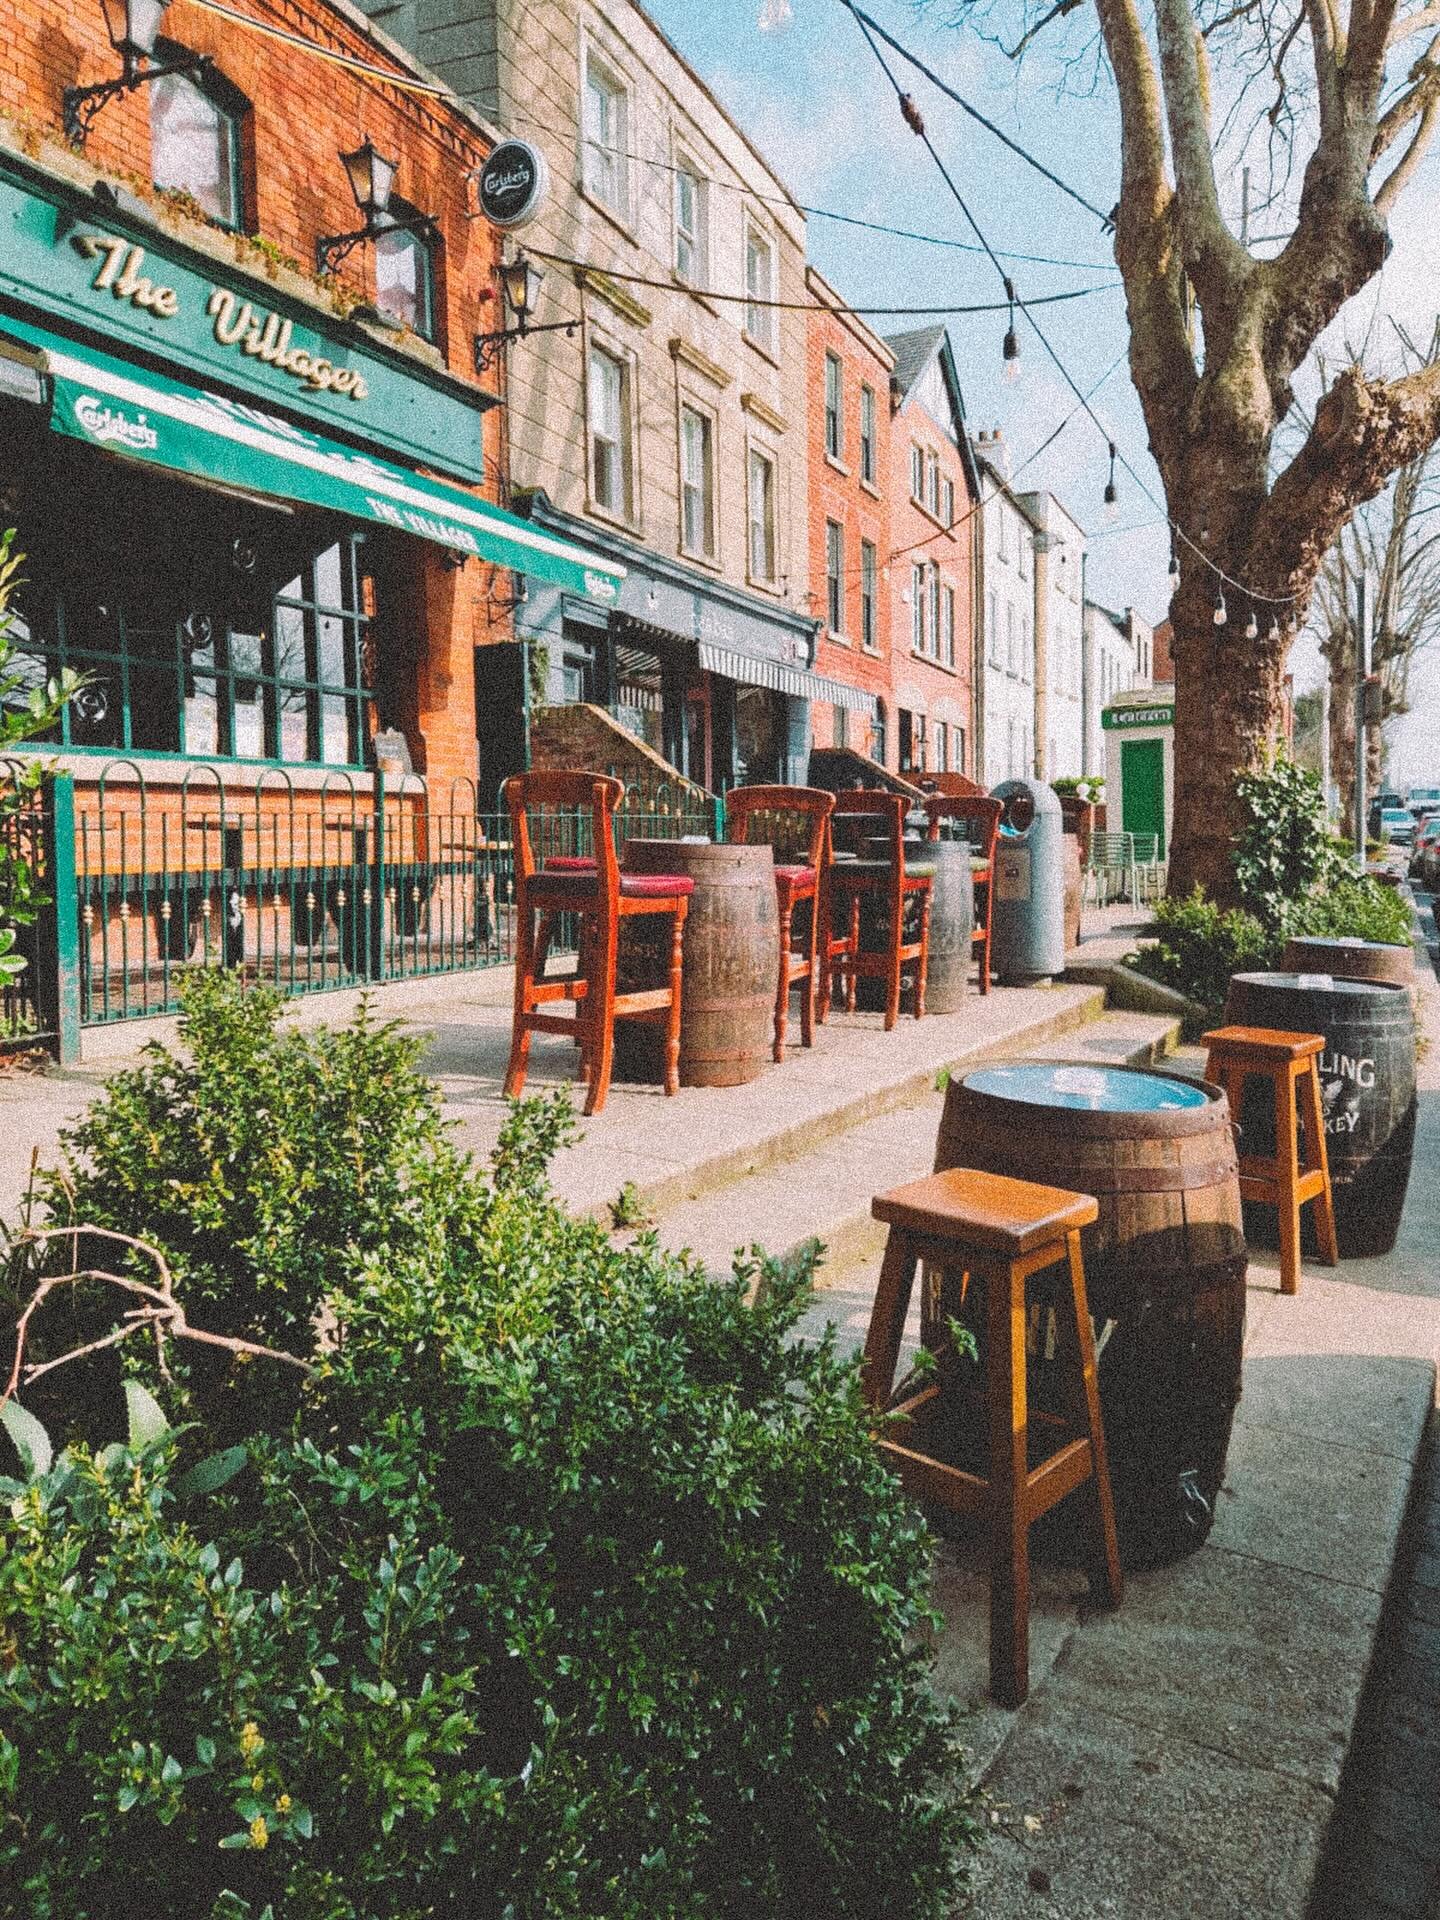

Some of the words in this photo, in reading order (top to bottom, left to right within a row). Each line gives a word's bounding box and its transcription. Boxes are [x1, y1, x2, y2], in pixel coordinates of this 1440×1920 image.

[484, 163, 529, 195] Carlsberg
[71, 234, 180, 317] The
[207, 287, 369, 400] Villager
[75, 394, 158, 450] Carlsberg
[364, 496, 405, 526] THE
[403, 510, 481, 553] VILLAGER
[1319, 1052, 1375, 1088] LING
[1324, 1111, 1360, 1134] KEY
